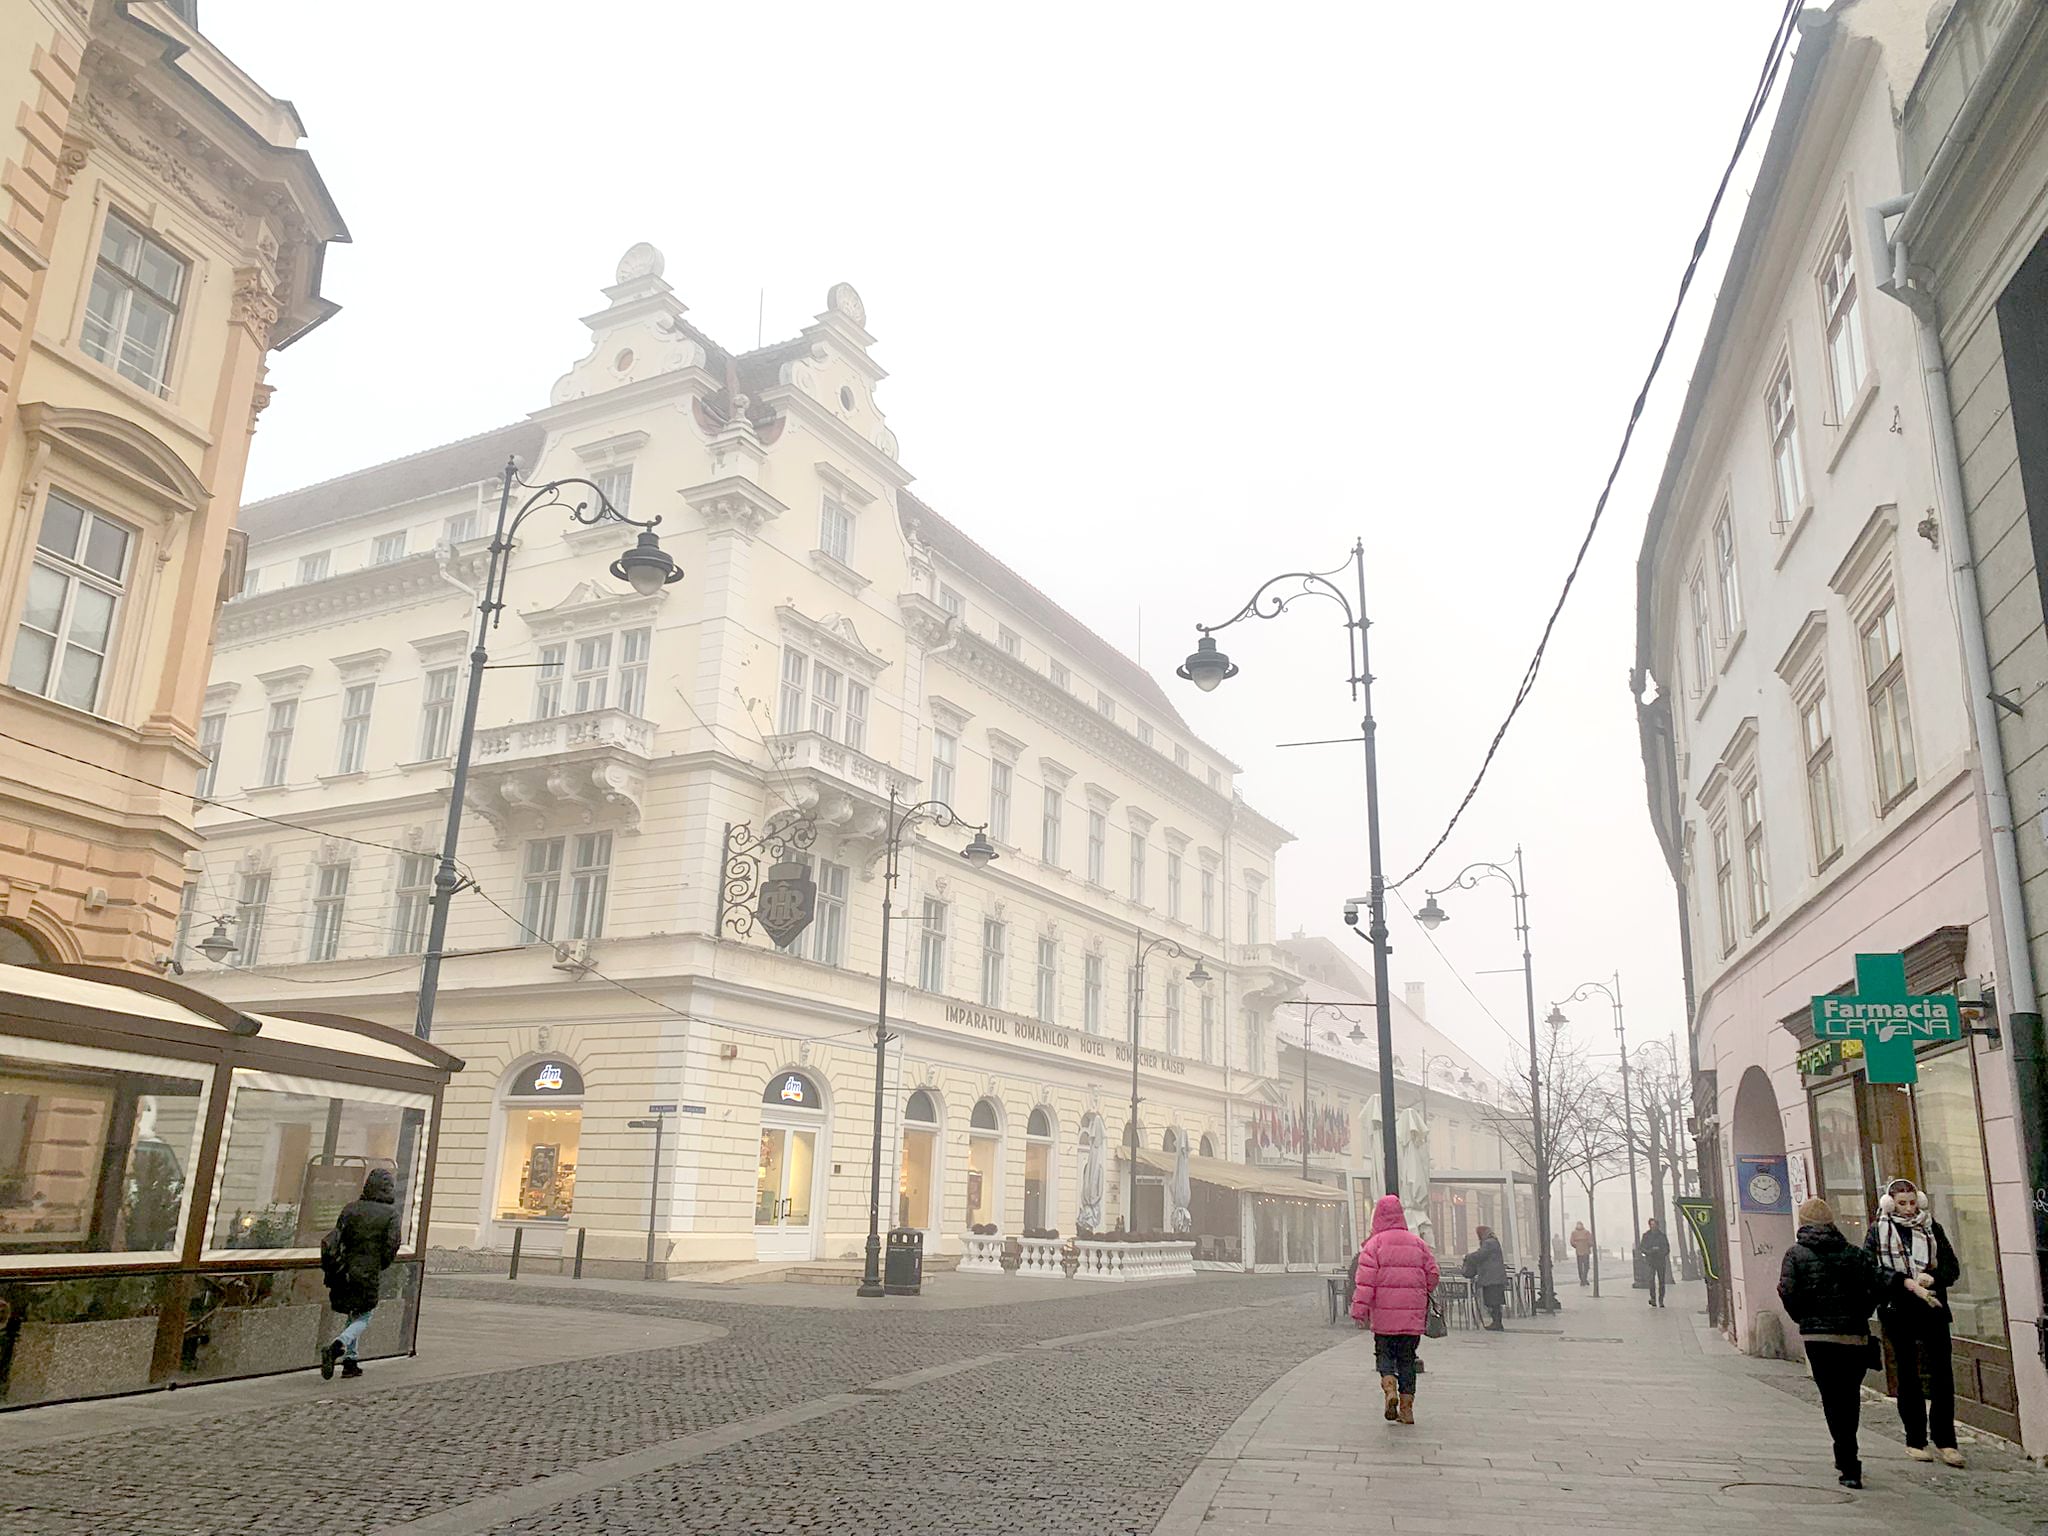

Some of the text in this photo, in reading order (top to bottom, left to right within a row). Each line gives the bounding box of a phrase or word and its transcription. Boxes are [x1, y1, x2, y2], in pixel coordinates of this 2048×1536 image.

[1824, 999, 1948, 1018] Farmacia
[1826, 1019, 1950, 1036] CATENA
[945, 1004, 1185, 1076] IMPARATUL ROMANILOR HOTEL RÖMCHER KAISER
[541, 1065, 560, 1080] dm
[785, 1077, 801, 1092] dm
